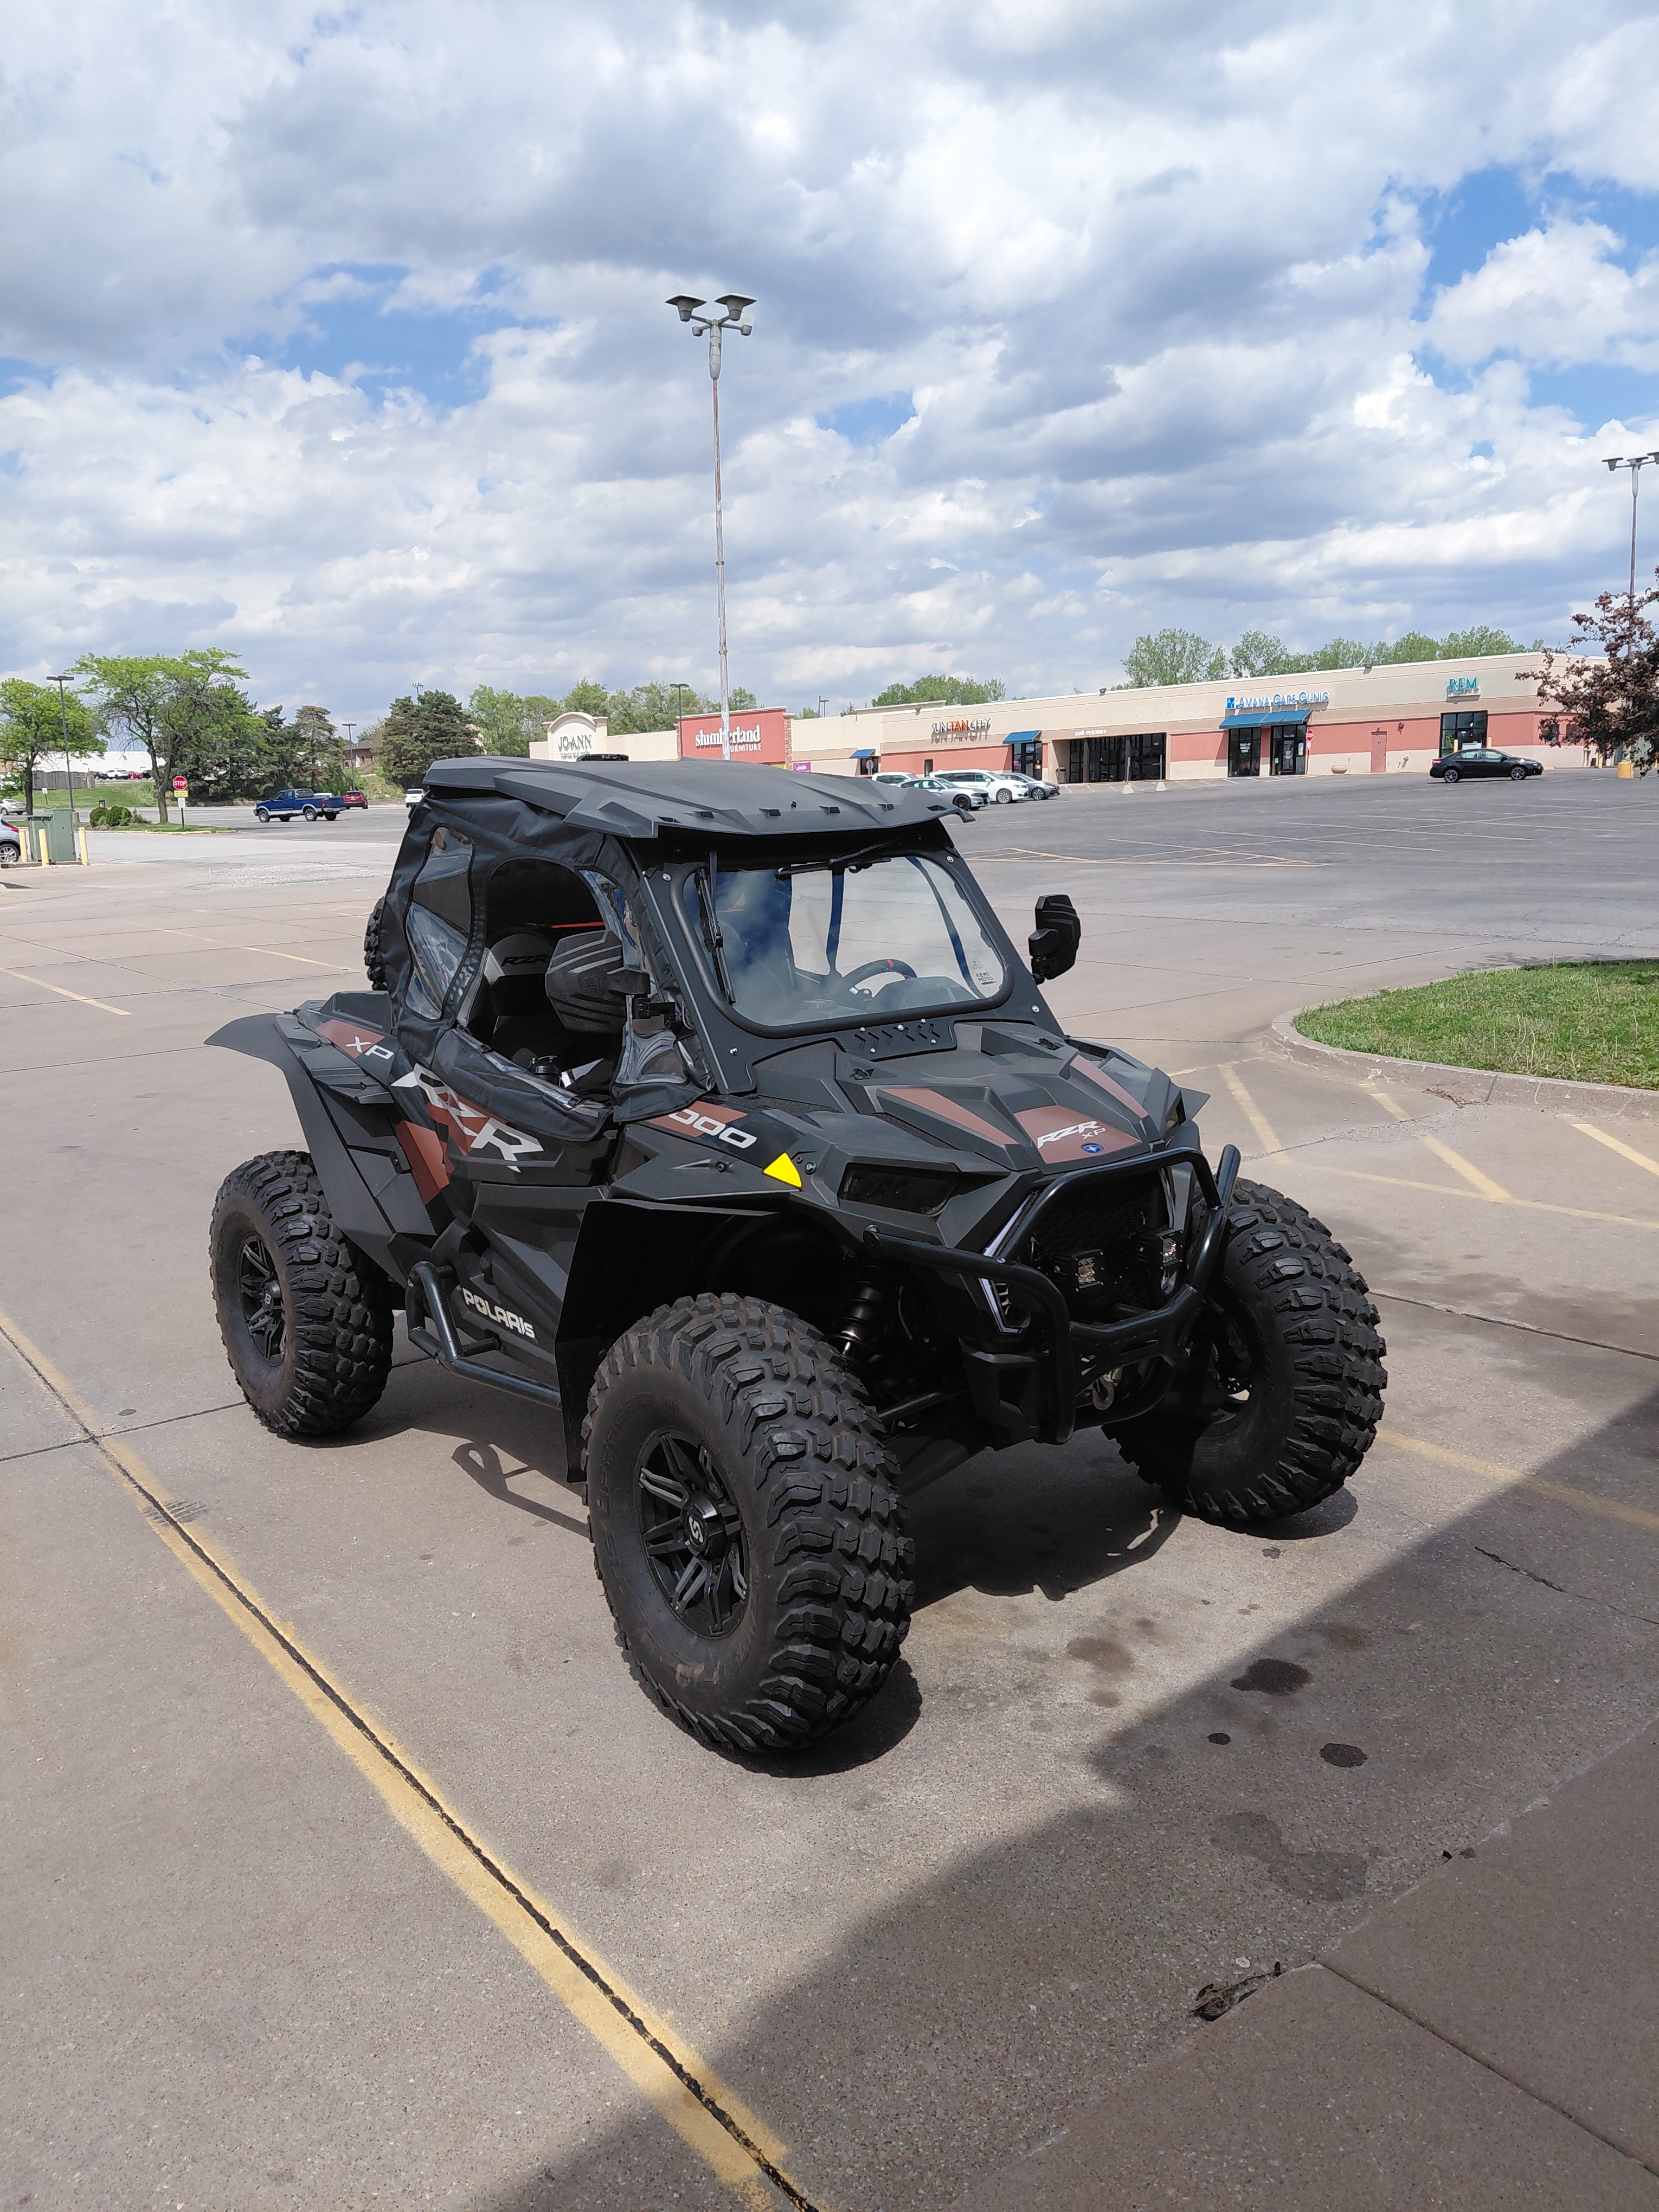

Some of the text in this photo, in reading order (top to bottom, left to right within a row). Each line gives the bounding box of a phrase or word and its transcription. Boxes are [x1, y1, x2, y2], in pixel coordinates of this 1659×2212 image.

[1448, 677, 1478, 694] REM
[1238, 691, 1330, 708] AMANA CARE CLINIC
[931, 717, 991, 733] SUN TAN CITY
[695, 724, 761, 746] slumrland
[730, 743, 762, 753] URNITURE
[344, 1036, 395, 1059] XP
[668, 1108, 757, 1148] 000
[1037, 1121, 1101, 1148] RZR
[1081, 1127, 1106, 1140] XP
[462, 1287, 535, 1339] POLARIS
